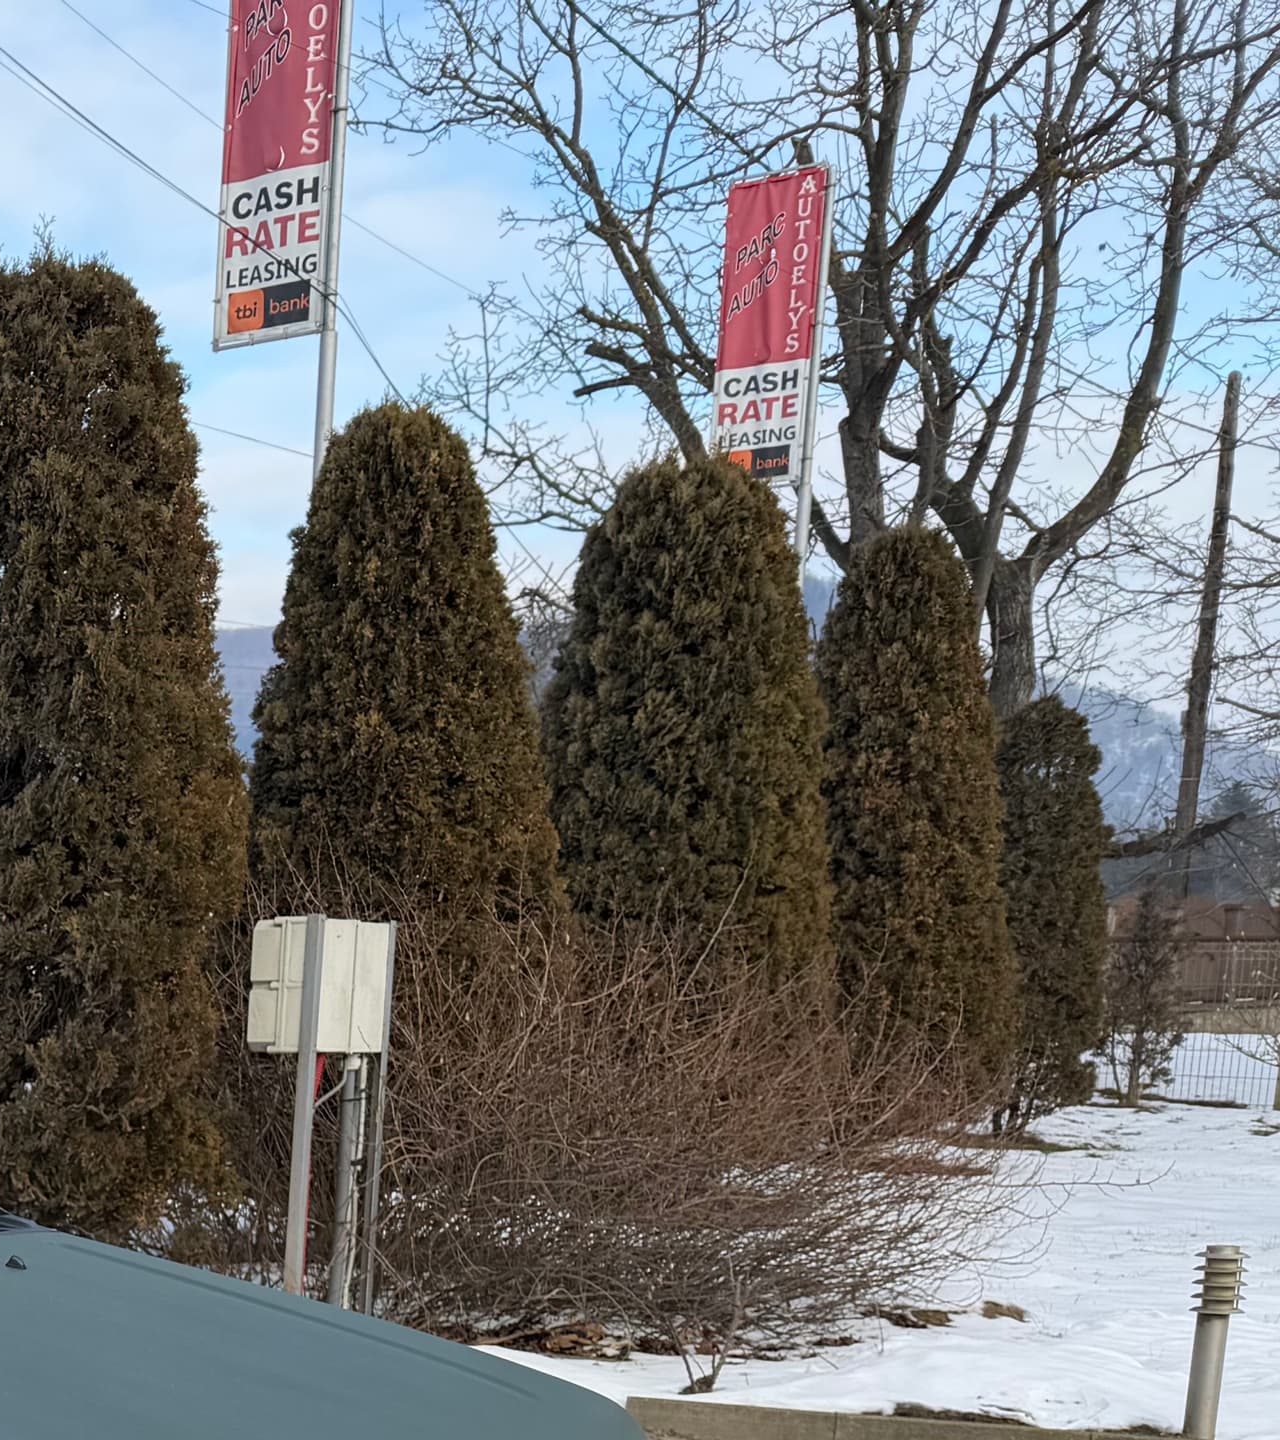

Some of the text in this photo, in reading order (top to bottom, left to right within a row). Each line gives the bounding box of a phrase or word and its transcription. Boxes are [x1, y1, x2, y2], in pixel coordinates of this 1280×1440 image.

[236, 27, 292, 119] AUTO
[232, 176, 320, 220] CASH
[225, 209, 321, 259] RATE
[735, 211, 787, 274] PARC
[225, 253, 318, 289] LEASING
[784, 174, 817, 354] AUTOELYS
[234, 292, 311, 321] tbi bank
[726, 258, 781, 323] AUTO
[723, 368, 800, 398] CASH
[717, 393, 800, 428] RATE
[719, 425, 797, 450] LEASING
[756, 454, 790, 470] bank
